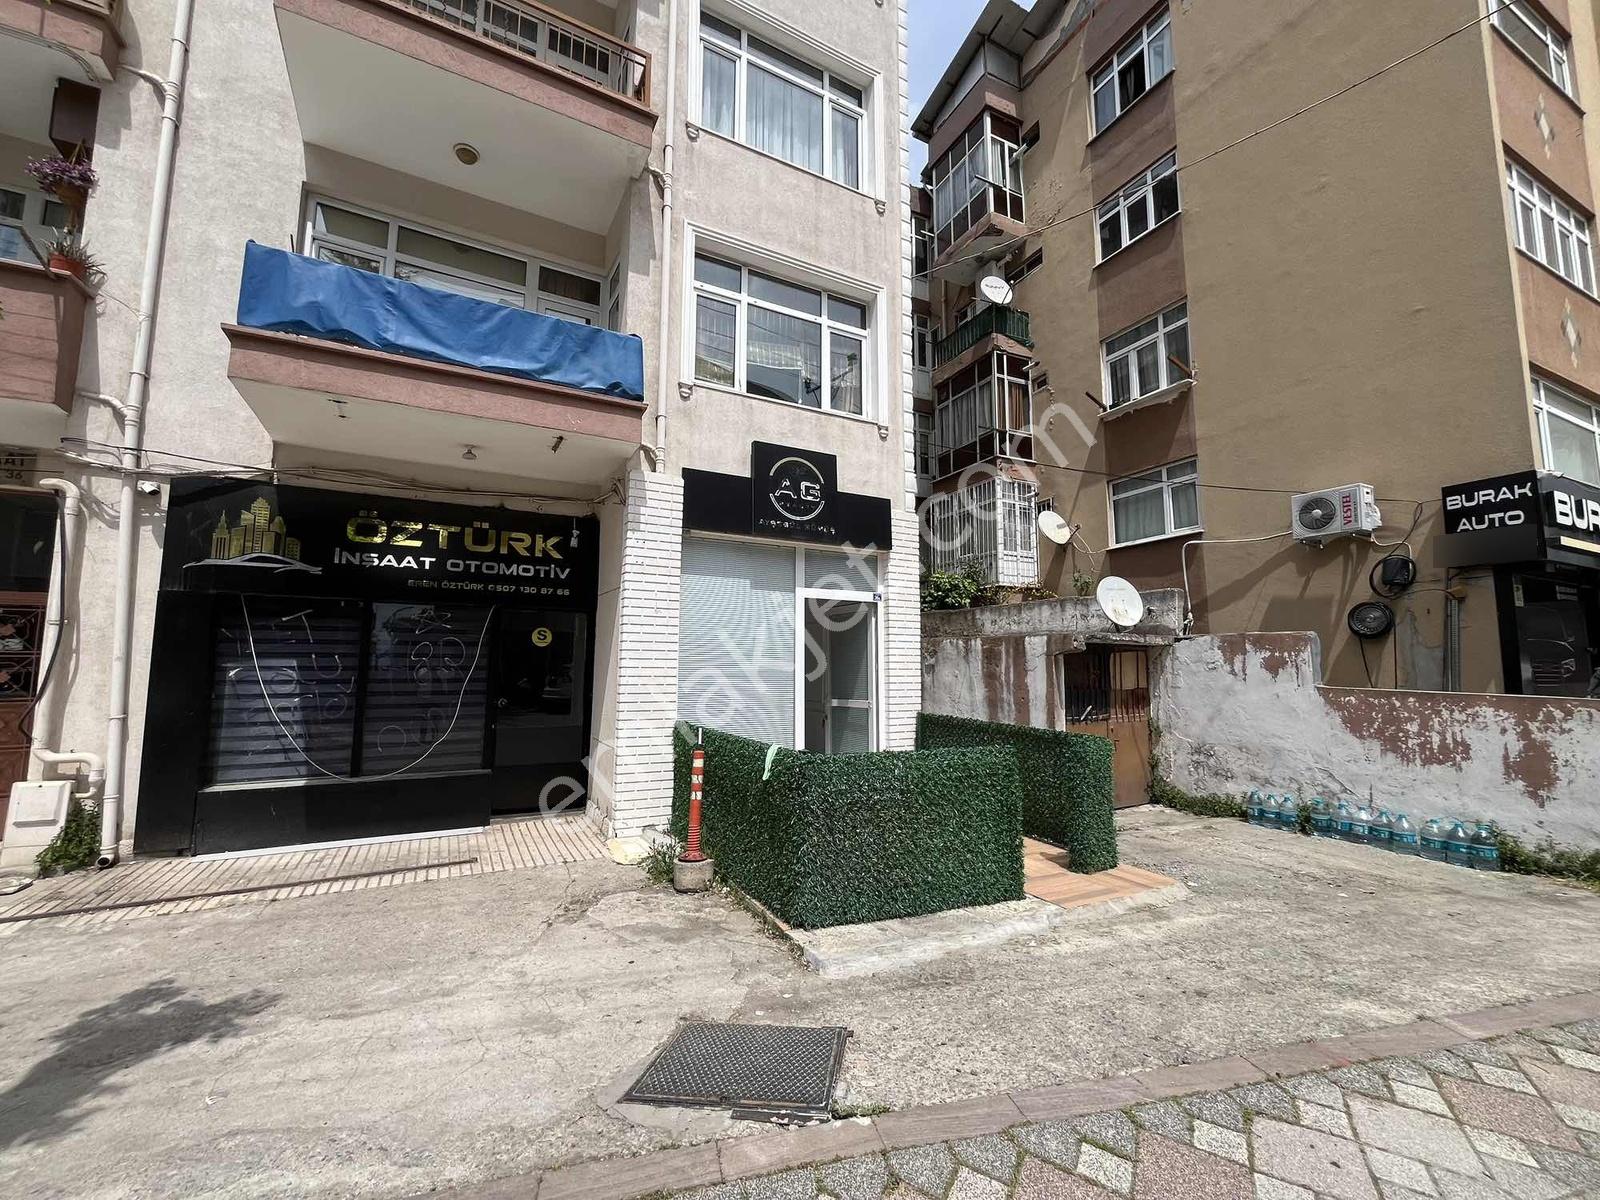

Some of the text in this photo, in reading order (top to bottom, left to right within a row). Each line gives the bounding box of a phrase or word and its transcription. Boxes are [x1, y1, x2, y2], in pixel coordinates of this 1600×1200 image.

[774, 478, 821, 501] AG
[1446, 482, 1533, 511] BURAK
[1342, 492, 1353, 527] VESTEL
[1456, 510, 1525, 533] AUTO
[346, 510, 564, 560] ÖZTÜRK
[333, 547, 571, 580] İNŞAAT OTOMOTİV
[407, 579, 438, 589] EREN
[441, 580, 484, 591] ÖZTÜRK
[488, 584, 516, 593] 0507
[520, 586, 537, 594] 130
[540, 587, 554, 595] 87
[537, 630, 547, 640] S
